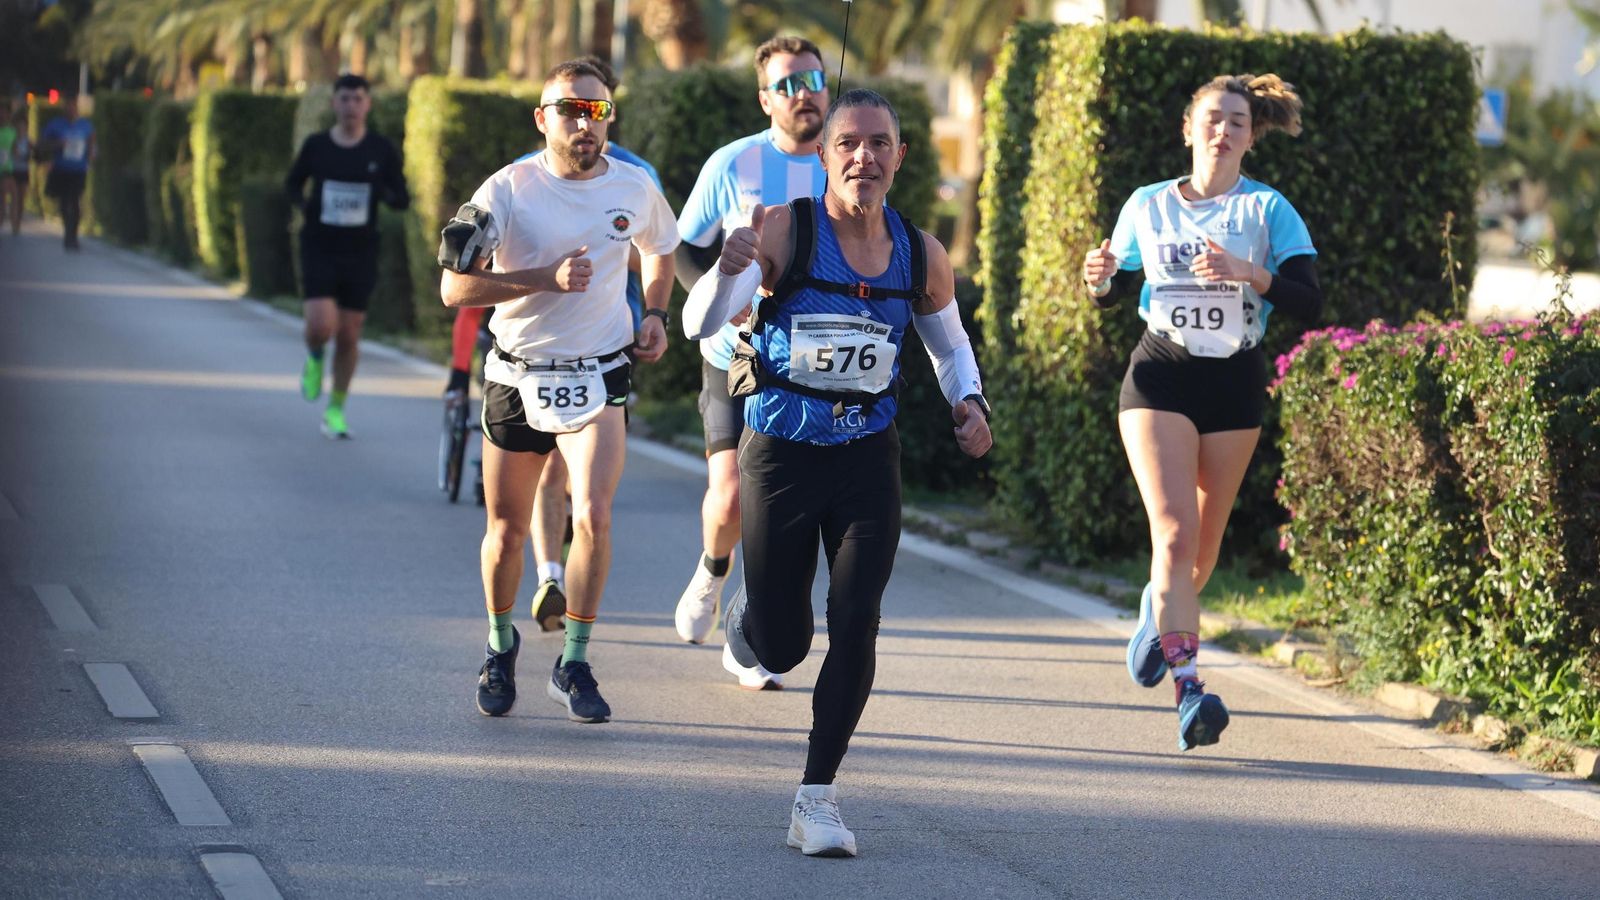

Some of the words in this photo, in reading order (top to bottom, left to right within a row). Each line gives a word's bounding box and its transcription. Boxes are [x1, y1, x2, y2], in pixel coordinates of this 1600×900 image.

[1171, 306, 1224, 331] 619
[815, 343, 877, 373] 576
[537, 385, 589, 410] 583
